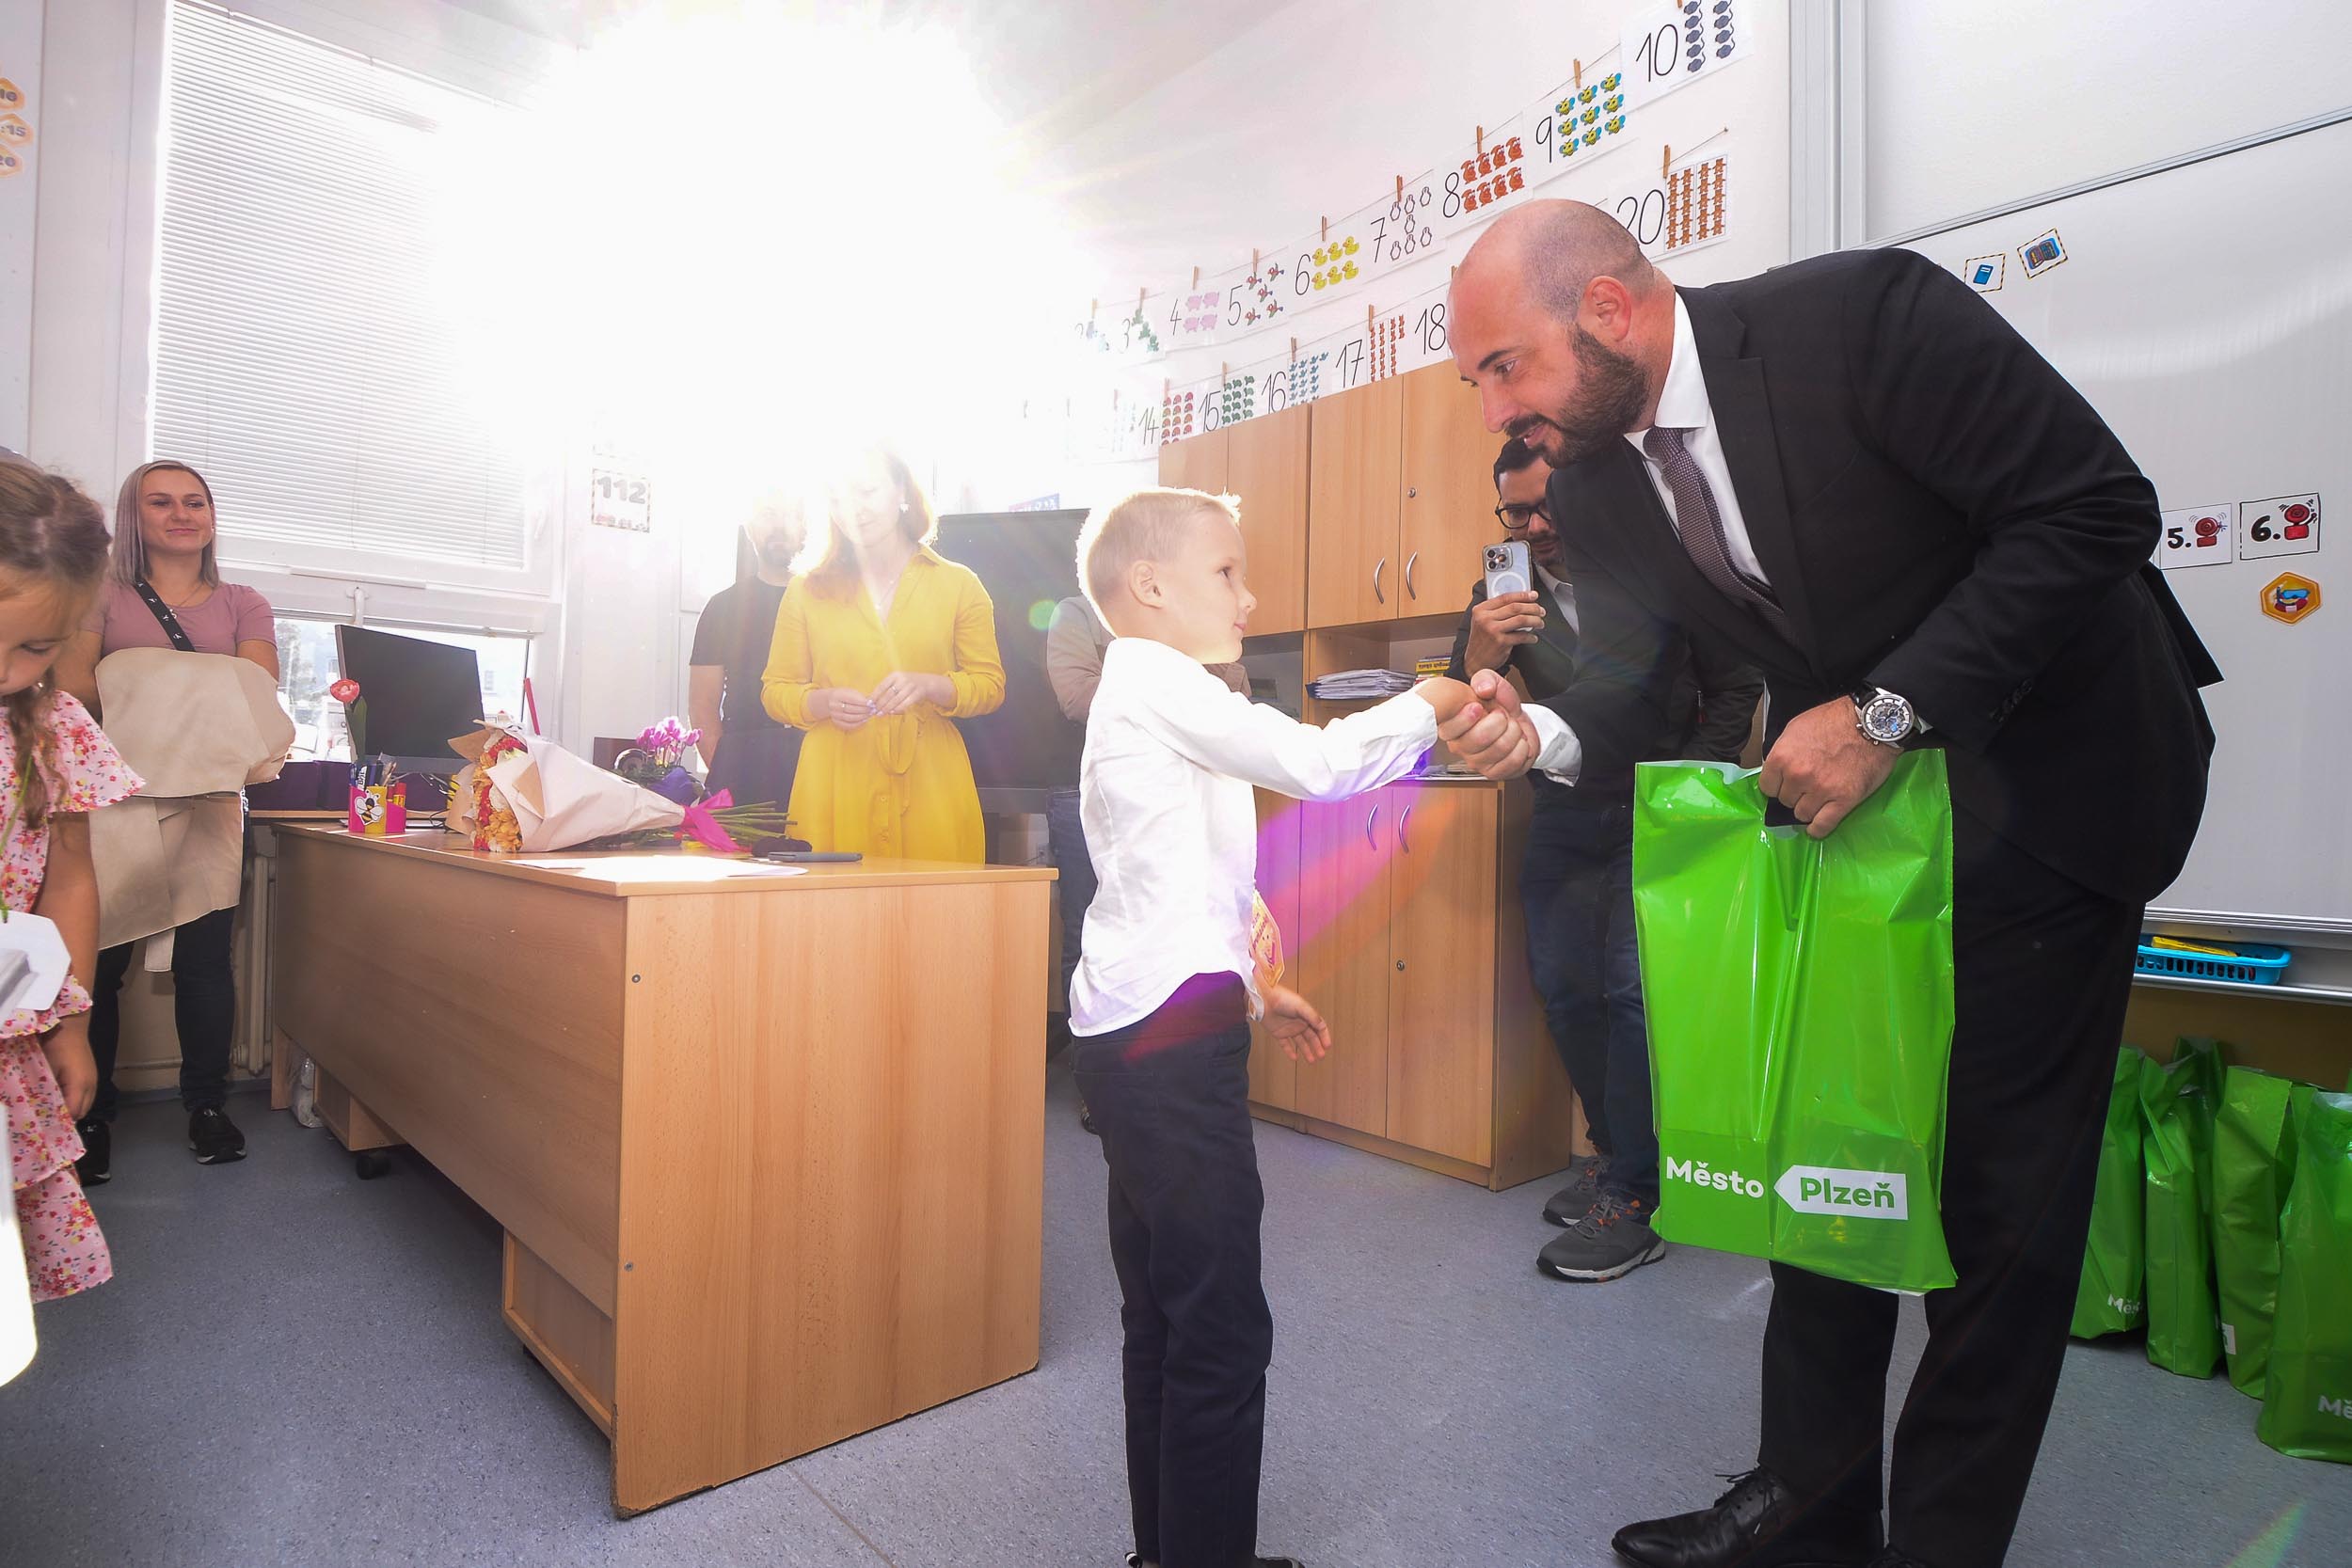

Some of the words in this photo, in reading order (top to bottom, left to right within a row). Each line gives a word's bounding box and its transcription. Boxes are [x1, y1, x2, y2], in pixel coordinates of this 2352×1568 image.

[1636, 24, 1678, 82] 10
[1535, 116, 1552, 163] 9
[1442, 172, 1460, 218] 8
[1616, 189, 1665, 245] 20
[1370, 217, 1387, 263] 7
[1295, 254, 1311, 295] 6
[1169, 298, 1183, 336] 4
[1227, 285, 1244, 326] 5
[1118, 318, 1131, 355] 3
[1414, 304, 1447, 355] 18
[1336, 340, 1364, 388] 17
[1199, 390, 1221, 432] 15
[1262, 372, 1287, 415] 16
[1138, 406, 1160, 445] 14
[597, 477, 646, 504] 112
[2167, 527, 2192, 549] 5.
[2250, 515, 2281, 542] 6.
[1666, 1156, 1764, 1198] Město
[1800, 1177, 1895, 1209] Plzeň
